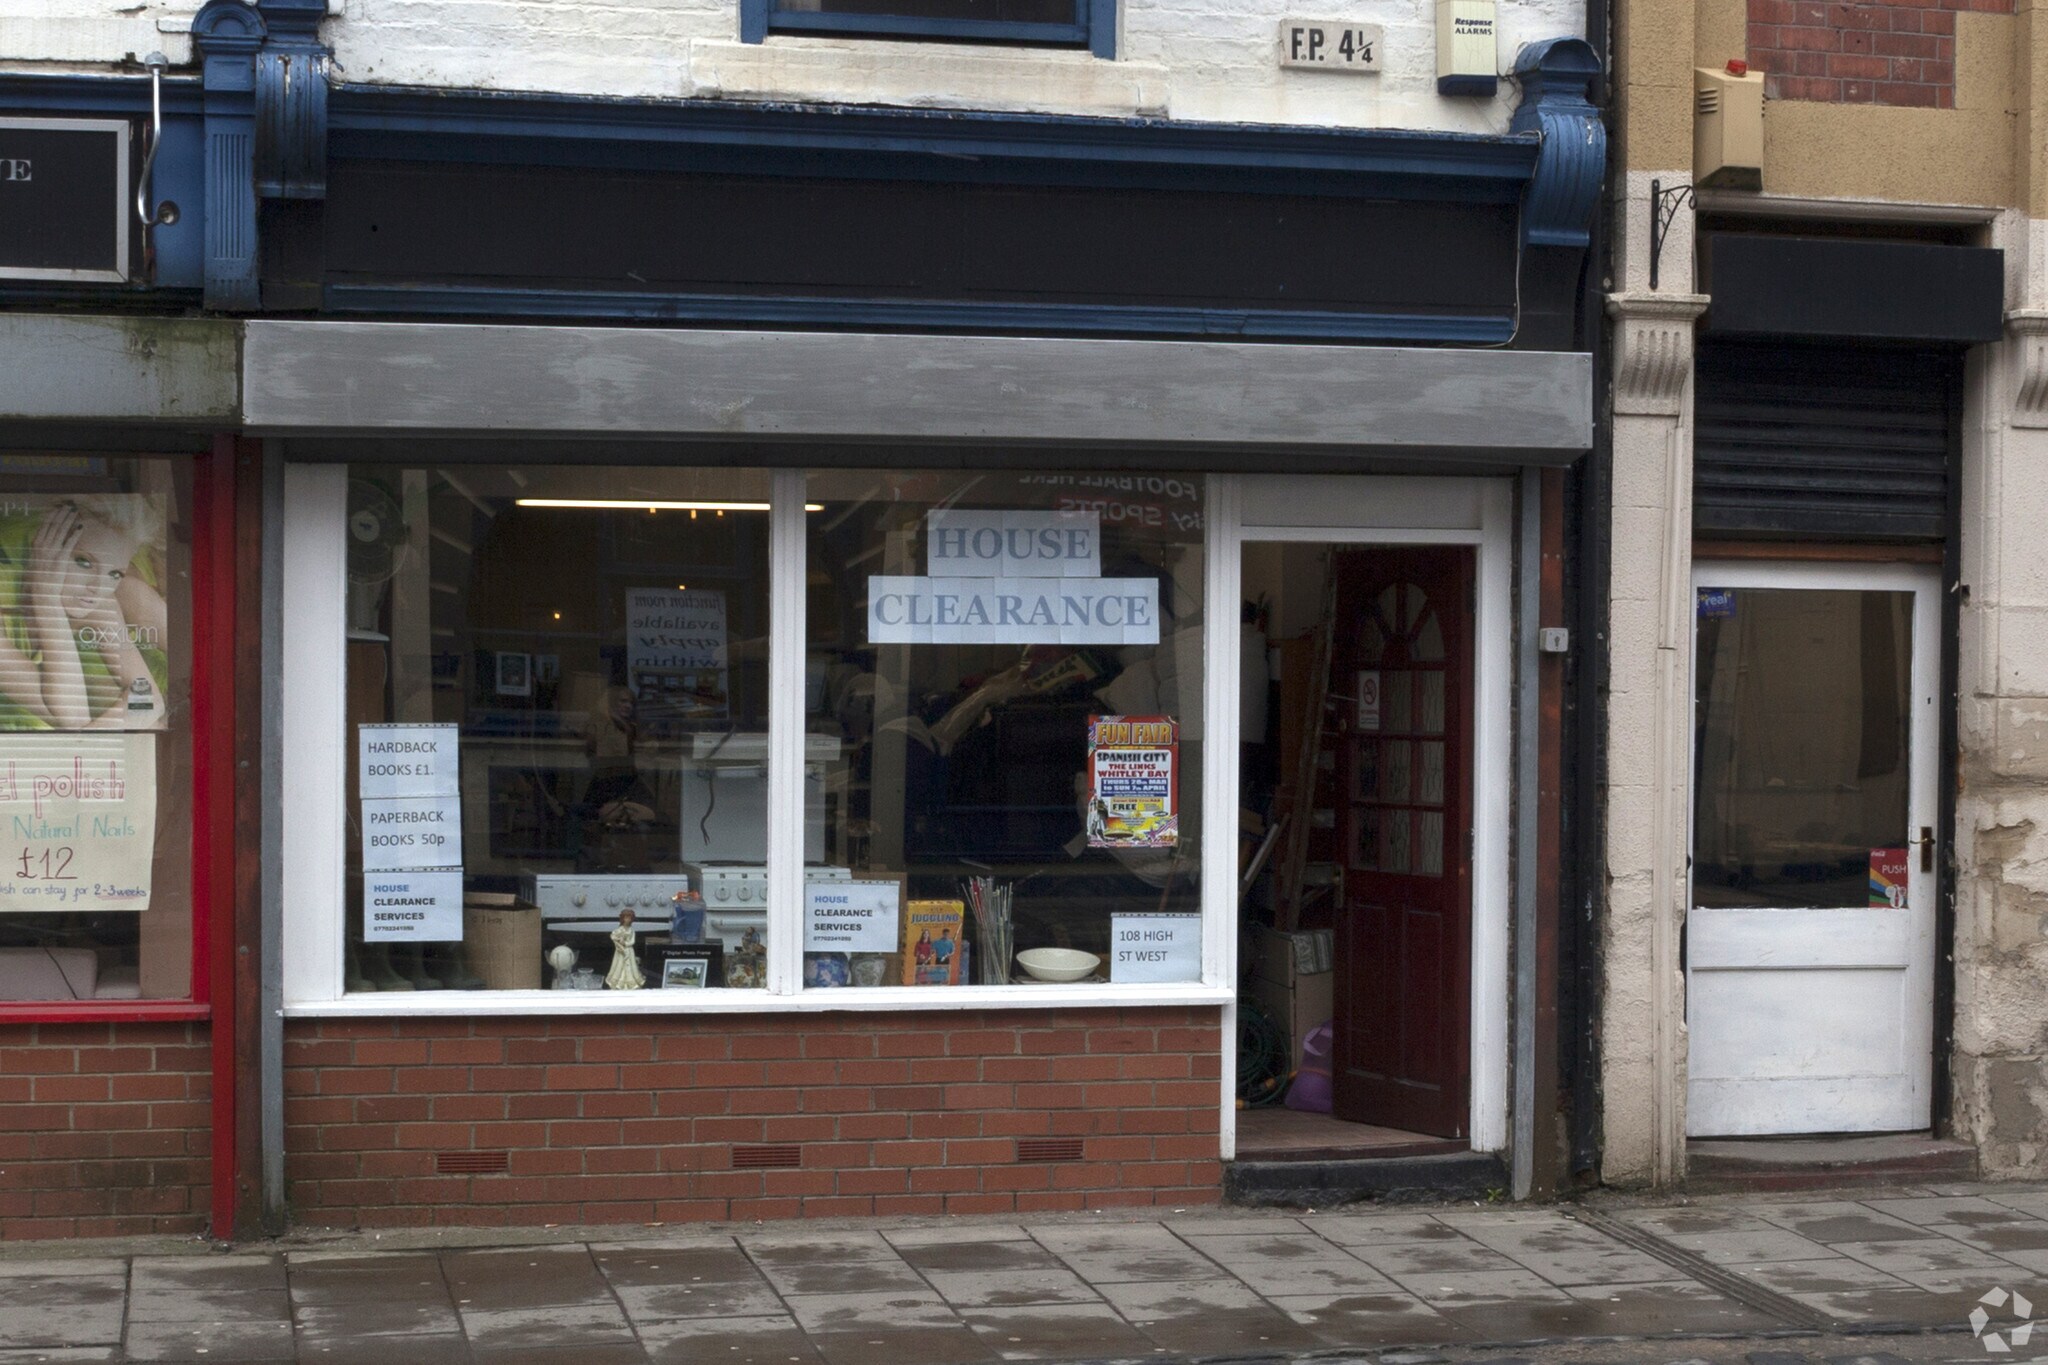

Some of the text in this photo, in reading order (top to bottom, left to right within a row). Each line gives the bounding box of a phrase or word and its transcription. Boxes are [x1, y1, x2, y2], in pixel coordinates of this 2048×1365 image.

[1455, 17, 1493, 27] Response
[1455, 27, 1493, 36] ALARMS
[934, 527, 1092, 560] HOUSE
[874, 593, 1151, 628] CLEARANCE
[1096, 723, 1172, 744] FUN FAIR
[368, 741, 438, 753] HARDBACK
[1097, 752, 1169, 762] SPANISH CITY
[368, 764, 434, 776] BOOKS £1.
[33, 755, 125, 819] polish
[370, 810, 445, 824] PAPERBACK
[13, 814, 136, 839] Natural Nails
[371, 833, 445, 847] BOOKS 50p
[16, 846, 78, 880] £12
[1882, 864, 1907, 874] PUSH
[22, 886, 41, 895] can
[45, 884, 67, 901] stay
[73, 886, 88, 902] for
[373, 884, 410, 893] HOUSE
[373, 897, 436, 906] CLEARANCE
[374, 912, 425, 921] SERVICES
[814, 909, 873, 917] CLEARANCE
[813, 923, 862, 931] SERVICES
[1120, 930, 1173, 941] 108 HIGH
[1119, 951, 1168, 961] ST WEST
